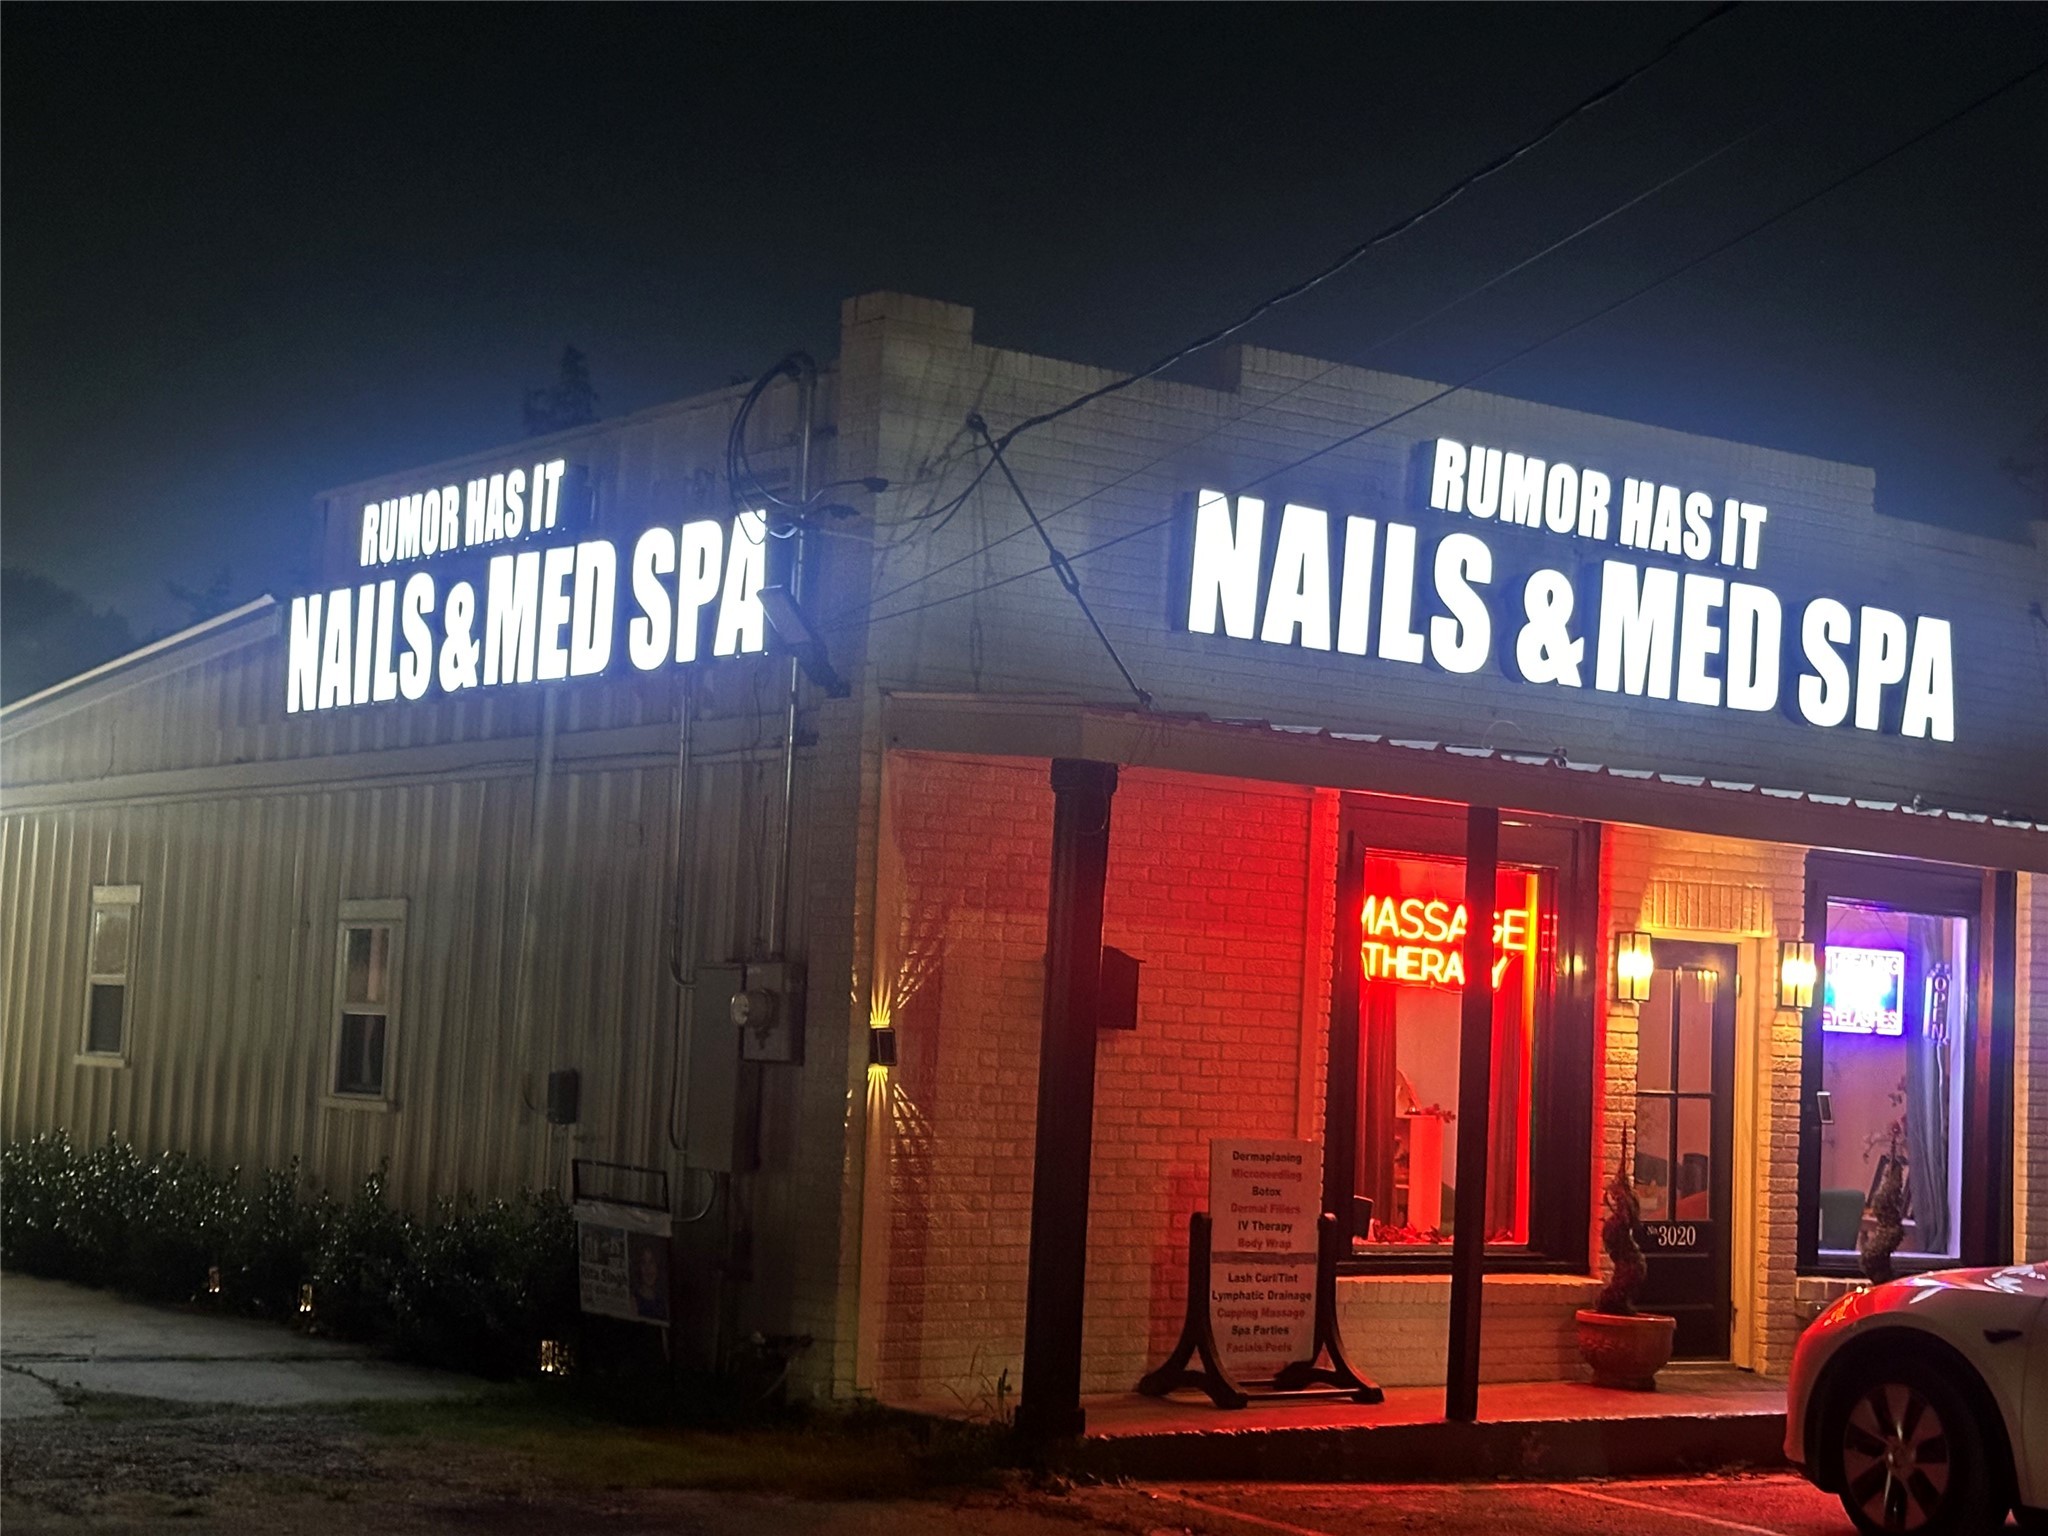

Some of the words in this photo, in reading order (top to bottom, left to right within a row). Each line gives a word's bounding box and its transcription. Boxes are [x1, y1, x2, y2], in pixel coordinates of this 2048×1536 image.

[1430, 438, 1612, 541] RUMOR
[1620, 478, 1713, 561] HAS
[1721, 499, 1768, 570] IT
[360, 485, 460, 569] RUMOR
[465, 469, 526, 548] HAS
[530, 460, 565, 533] IT
[287, 572, 435, 713] NAILS
[439, 582, 480, 692] &
[483, 540, 616, 686] MED
[629, 510, 767, 670] SPA
[1188, 489, 1492, 673] NAILS
[1516, 569, 1584, 688] &
[1595, 560, 1782, 712] MED
[1798, 598, 1954, 742] SPA
[1361, 894, 1530, 951] MASSAE
[1361, 941, 1508, 988] THERAY
[1931, 976, 1948, 1040] OPEN
[1232, 1150, 1302, 1165] Dermaplaning
[1231, 1168, 1302, 1182] Microneedling
[1252, 1186, 1281, 1196] Botox
[1231, 1203, 1267, 1213] Dermal
[1270, 1204, 1301, 1214] Fillers
[1238, 1220, 1249, 1230] IV
[1252, 1221, 1293, 1233] Therapy
[1658, 1225, 1696, 1246] 3020
[1238, 1238, 1263, 1250] Body
[1266, 1239, 1292, 1250] Wrap
[1228, 1273, 1252, 1283] Lash
[1212, 1290, 1264, 1302] Lymphatic
[1267, 1290, 1312, 1302] Drainage
[1217, 1308, 1258, 1320] Cupping
[1261, 1308, 1305, 1319] Massage
[1231, 1325, 1251, 1336] Spa
[1253, 1325, 1289, 1335] Parties
